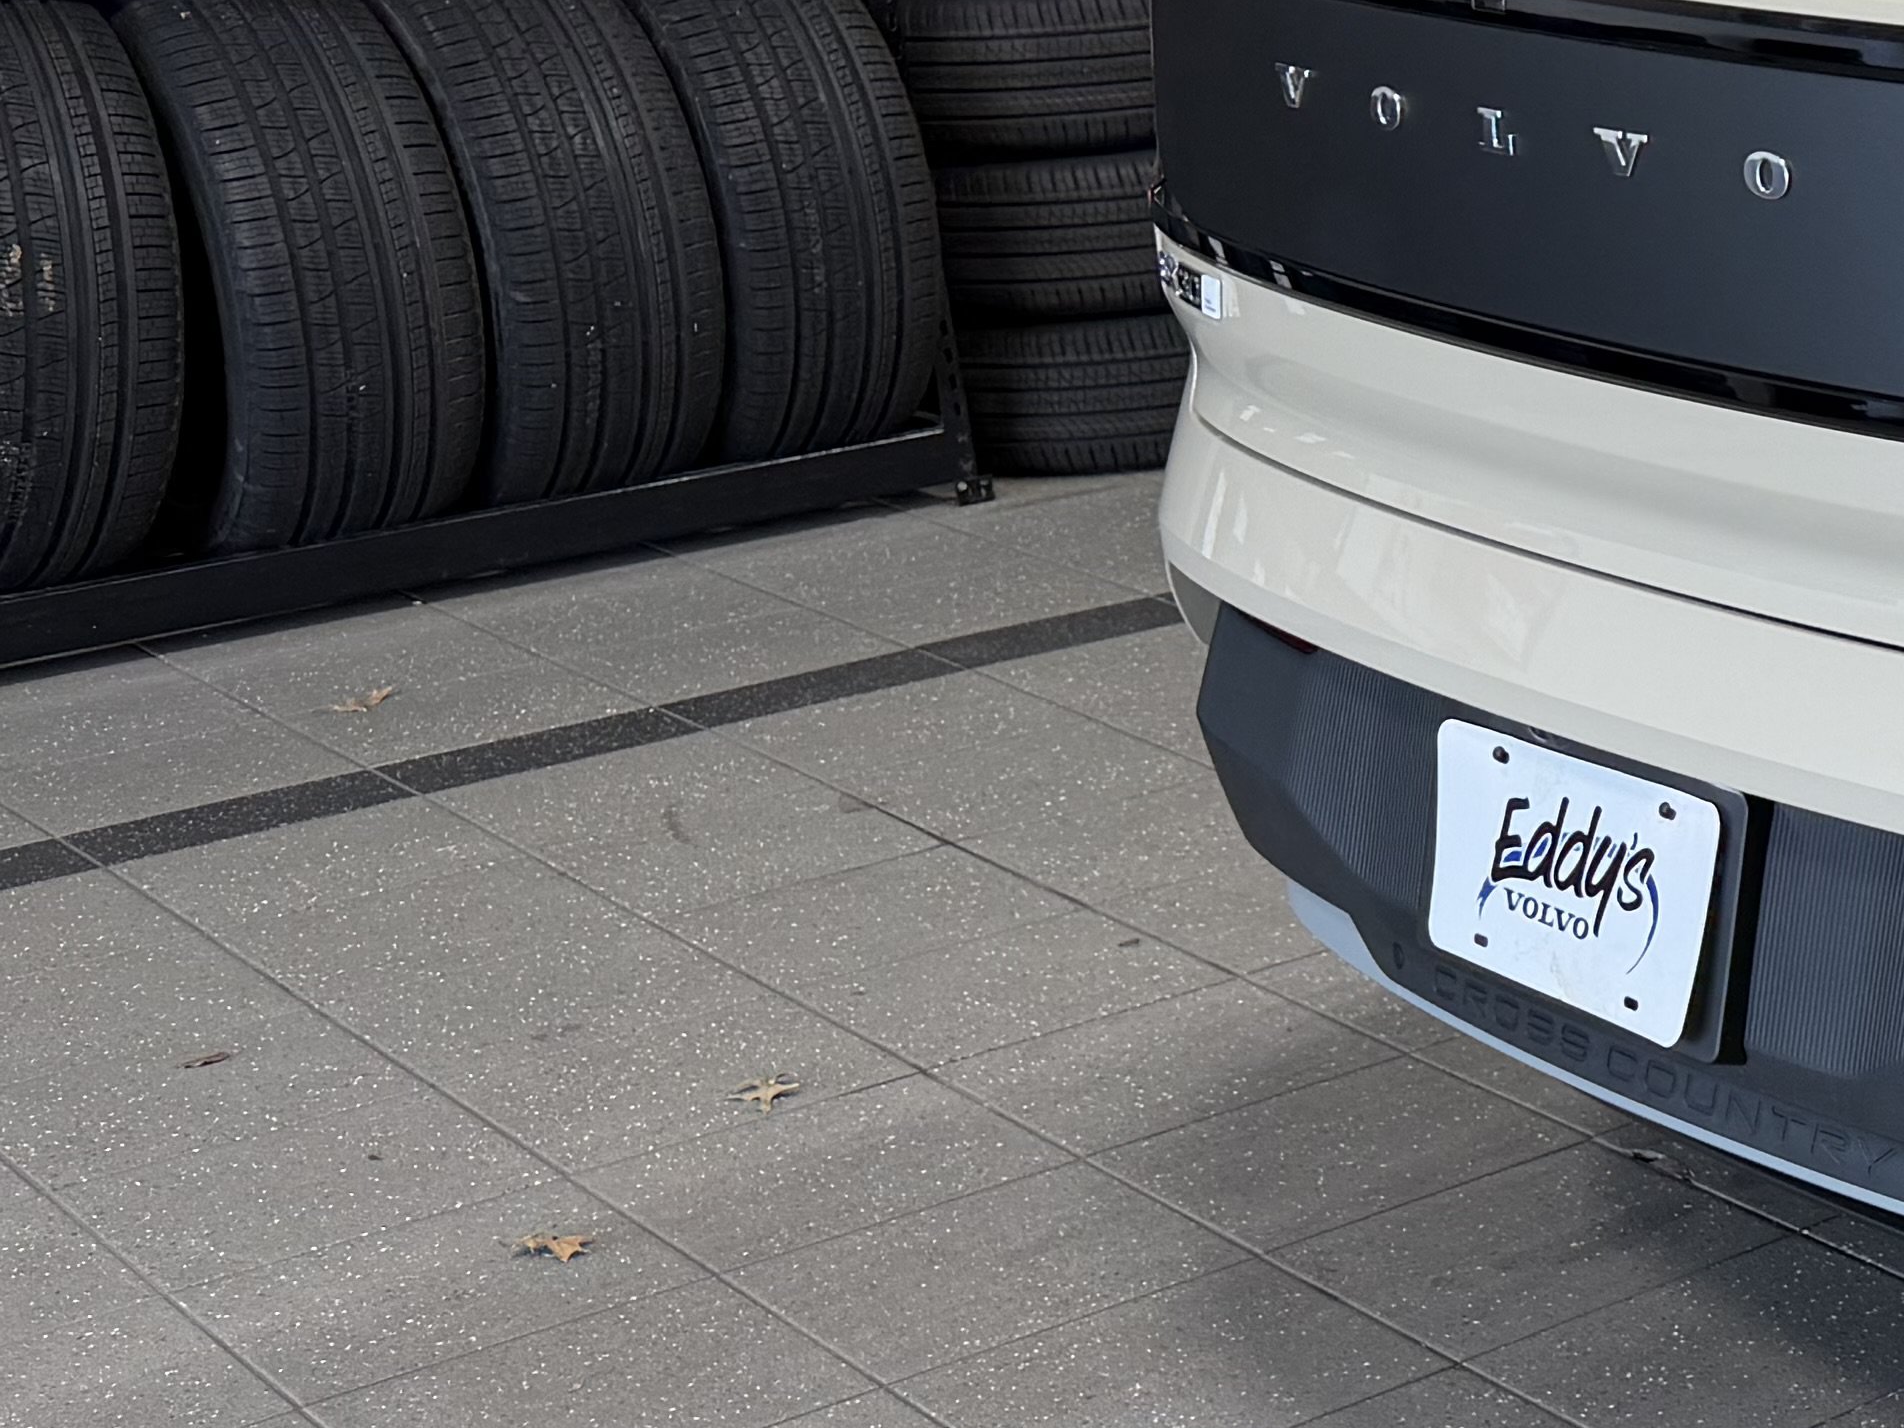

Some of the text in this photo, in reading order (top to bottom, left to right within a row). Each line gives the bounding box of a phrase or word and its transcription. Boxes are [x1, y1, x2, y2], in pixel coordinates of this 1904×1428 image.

[1274, 60, 1792, 201] VOLVO
[1490, 796, 1656, 938] Eddy's
[1504, 887, 1590, 940] VOLVO
[1433, 968, 1898, 1175] CROSS COUNTRY
